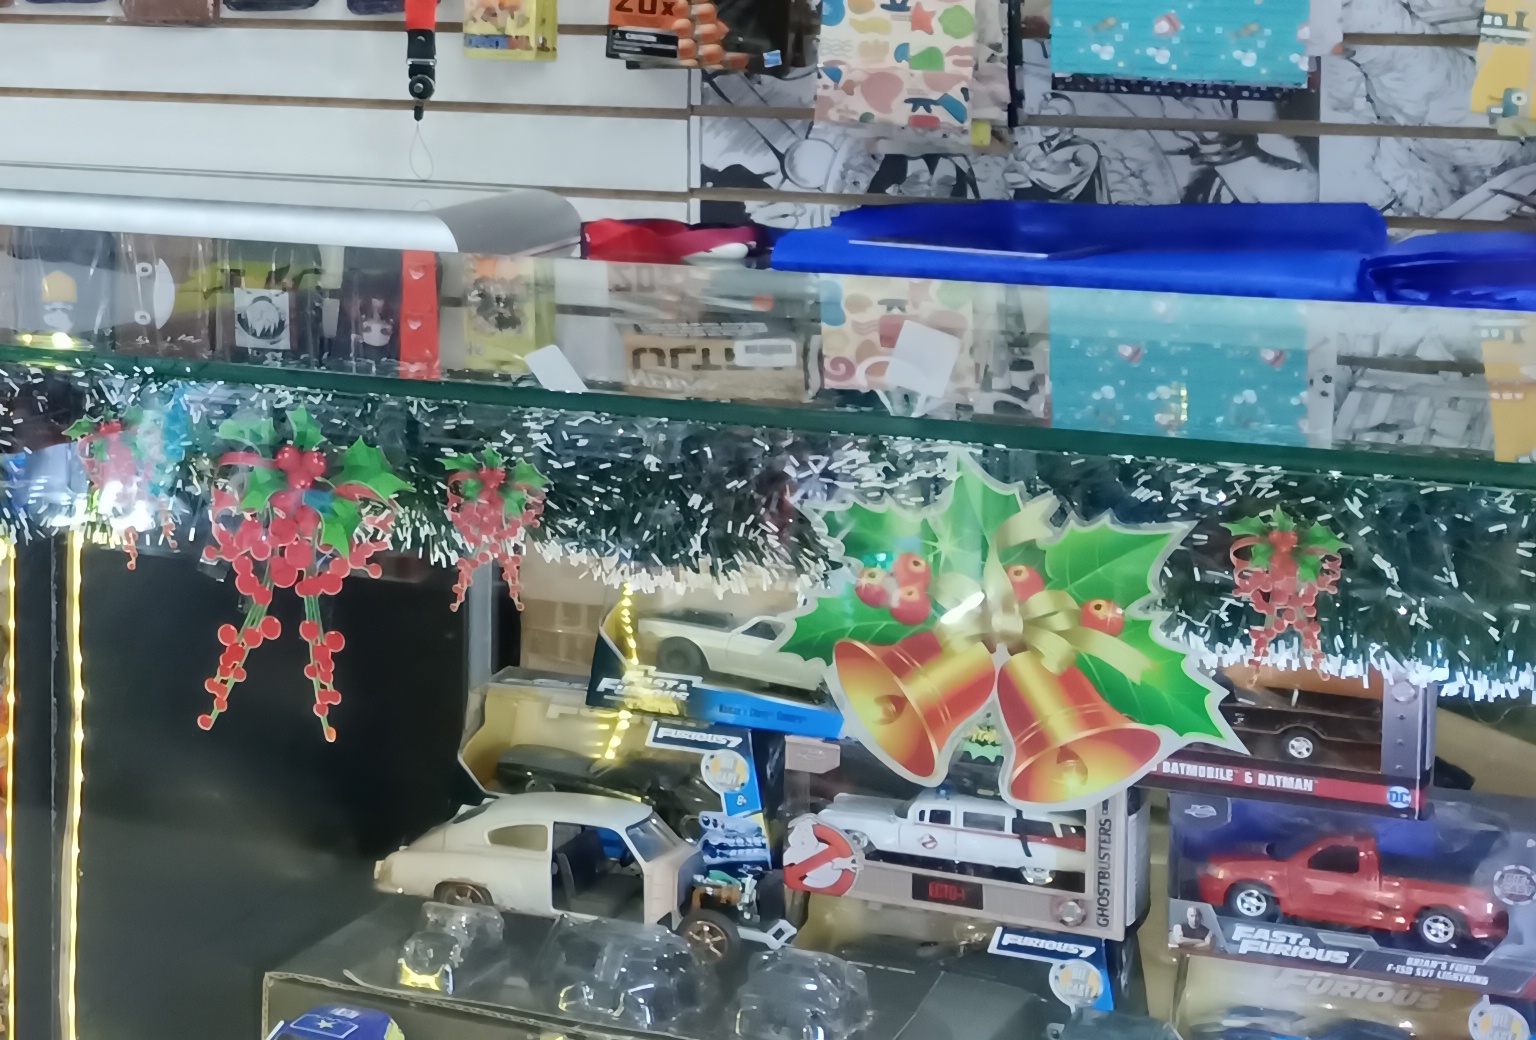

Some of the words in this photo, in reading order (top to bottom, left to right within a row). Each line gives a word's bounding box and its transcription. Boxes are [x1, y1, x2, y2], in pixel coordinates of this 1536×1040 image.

[1257, 776, 1314, 792] BATMAN
[1387, 792, 1410, 805] DC
[1096, 818, 1112, 928] GHOSTBUSTERS
[1231, 924, 1303, 945] FAST
[1238, 939, 1350, 964] FURIOUS
